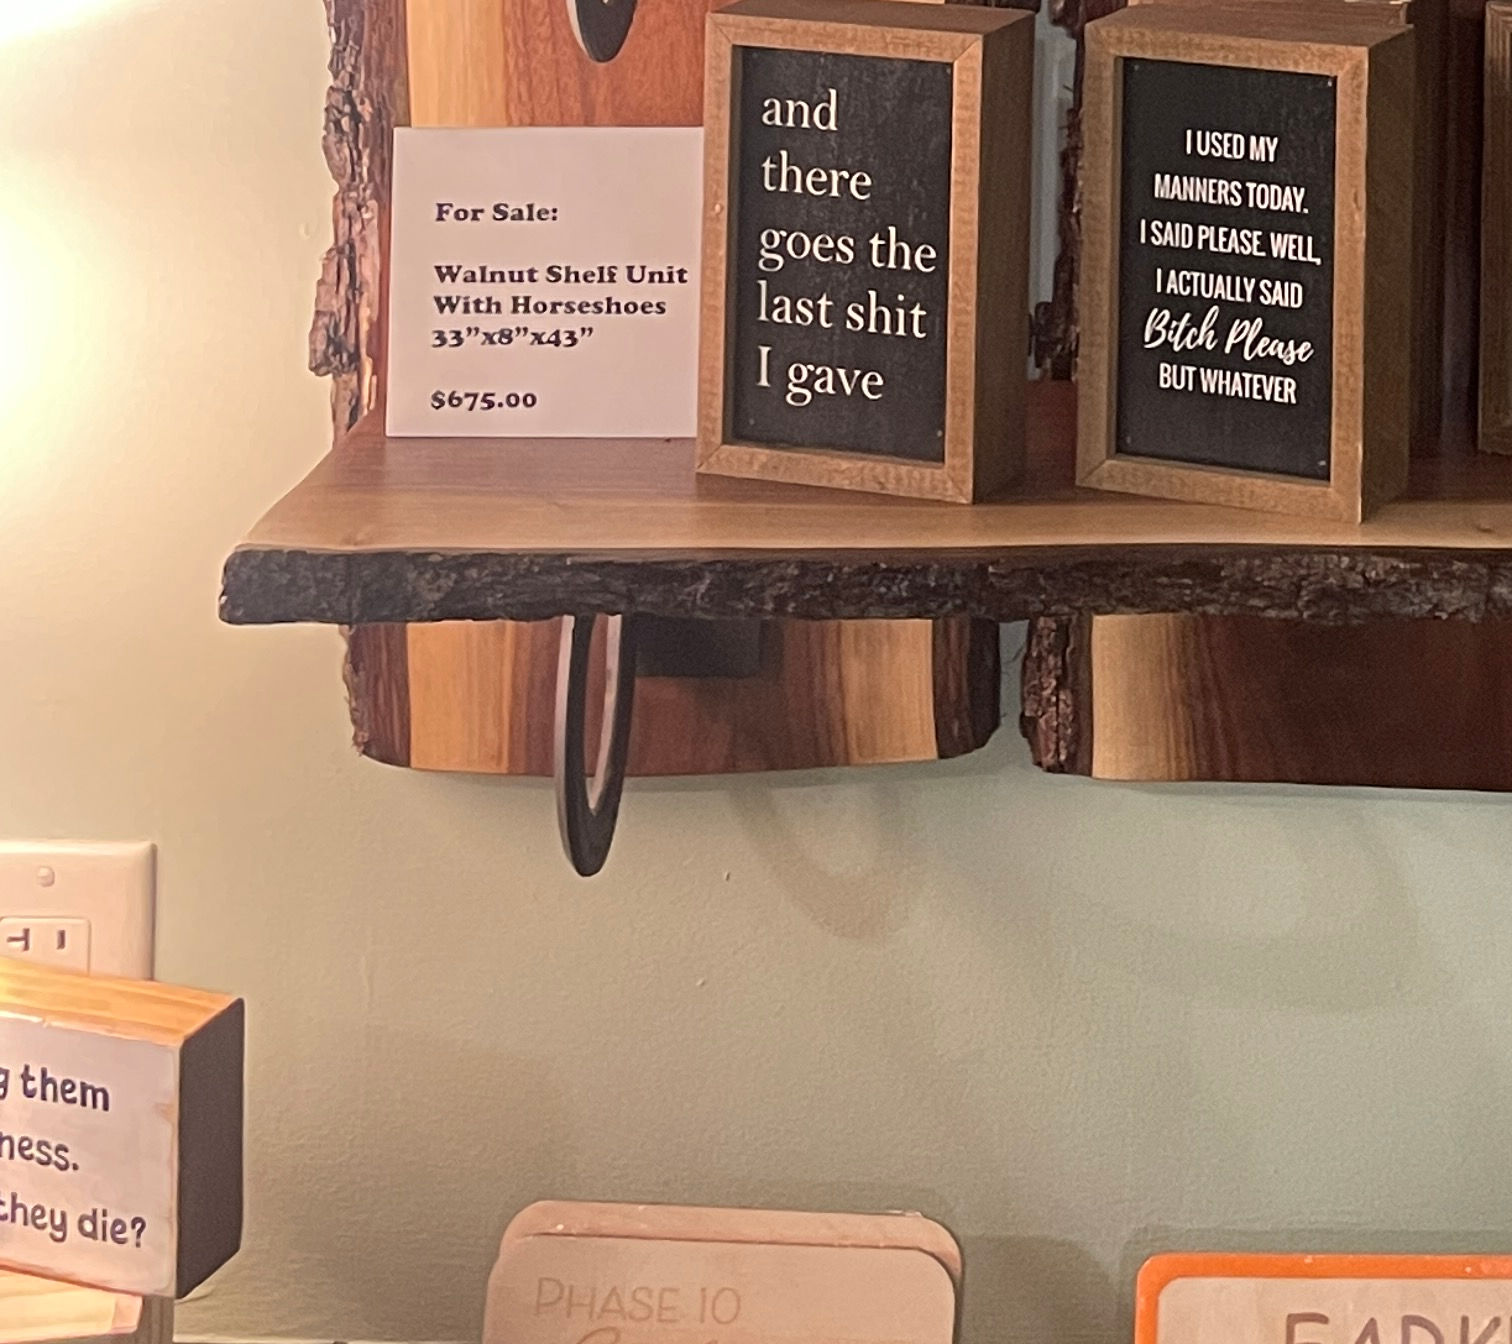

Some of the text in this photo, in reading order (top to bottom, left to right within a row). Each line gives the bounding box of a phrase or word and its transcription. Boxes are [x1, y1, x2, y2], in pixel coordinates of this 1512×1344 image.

[762, 90, 838, 131] and
[1186, 130, 1278, 162] I USED MY
[762, 152, 872, 201] there
[1154, 174, 1309, 213] MANNERS TODAY.
[435, 202, 559, 223] For Sale:
[759, 228, 937, 273] goes the
[1140, 219, 1146, 244] I
[1151, 220, 1193, 249] SAID
[434, 264, 688, 284] Walnut Shelf Unit
[1156, 268, 1303, 308] I ACTUALLY SAID
[433, 296, 666, 315] With Horseshoes
[757, 280, 927, 339] last shit
[1144, 306, 1314, 365] Bitch Please
[756, 346, 885, 406] I gave
[1159, 364, 1297, 404] BUT WHATEVER
[431, 390, 537, 411] $675.00
[21, 1064, 109, 1111] them
[78, 1208, 146, 1247] die?
[534, 1277, 680, 1322] PHASE
